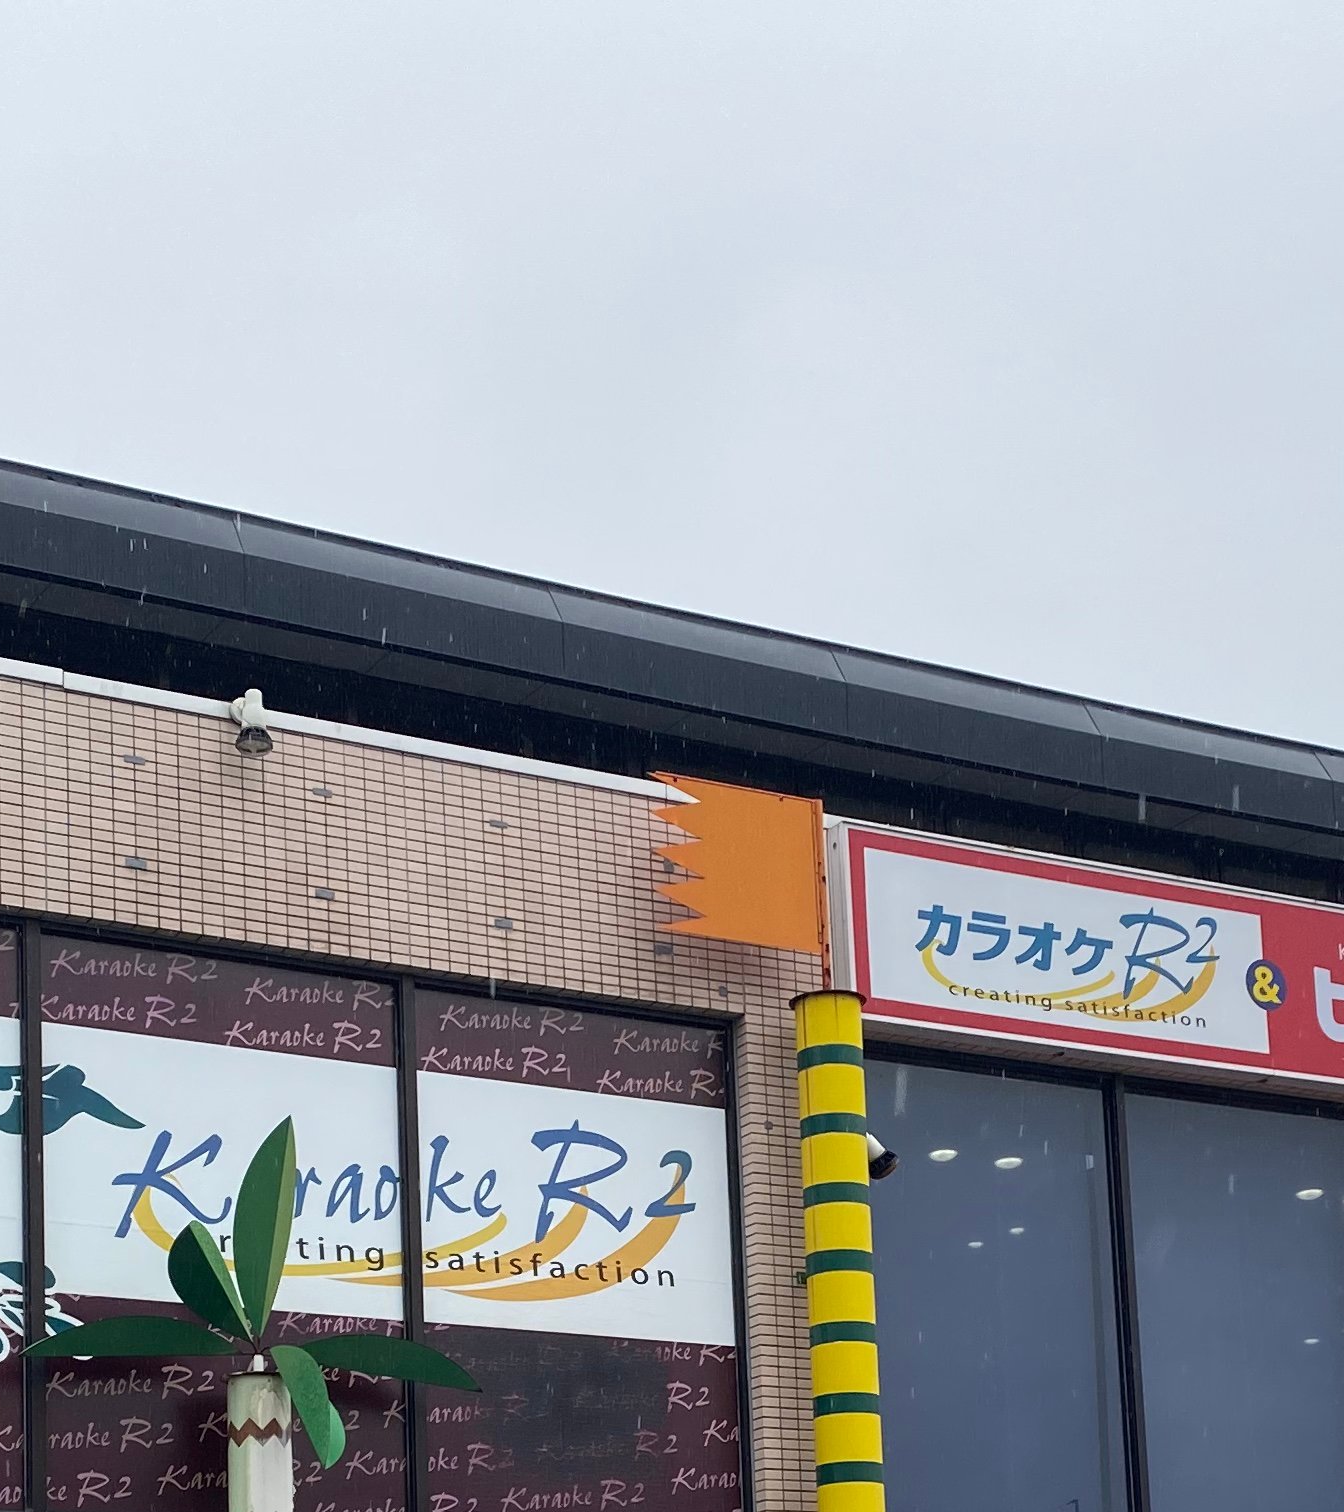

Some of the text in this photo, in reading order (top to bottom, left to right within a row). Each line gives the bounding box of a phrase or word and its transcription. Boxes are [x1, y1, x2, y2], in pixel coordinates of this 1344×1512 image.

[915, 904, 1114, 976] カラオケ
[50, 949, 218, 985] Karaoke R2
[1251, 963, 1283, 1005] &
[244, 976, 344, 1005] Karaoke
[948, 983, 1207, 1029] creating satisfaction
[145, 993, 198, 1029] R2
[439, 1004, 585, 1037] Karaoke R2
[224, 1020, 383, 1054] Karaoke R2
[613, 1028, 699, 1056] Karaoke
[420, 1045, 567, 1078] Karaoke R2
[596, 1069, 683, 1096] Karaoke
[112, 1119, 697, 1243] Kraoke R2
[425, 1245, 676, 1288] satisfaction
[46, 1362, 215, 1401] Karaoke R2
[667, 1380, 710, 1413] R2
[119, 1416, 174, 1453] R2
[77, 1469, 133, 1508] R2
[600, 1479, 645, 1511] R2
